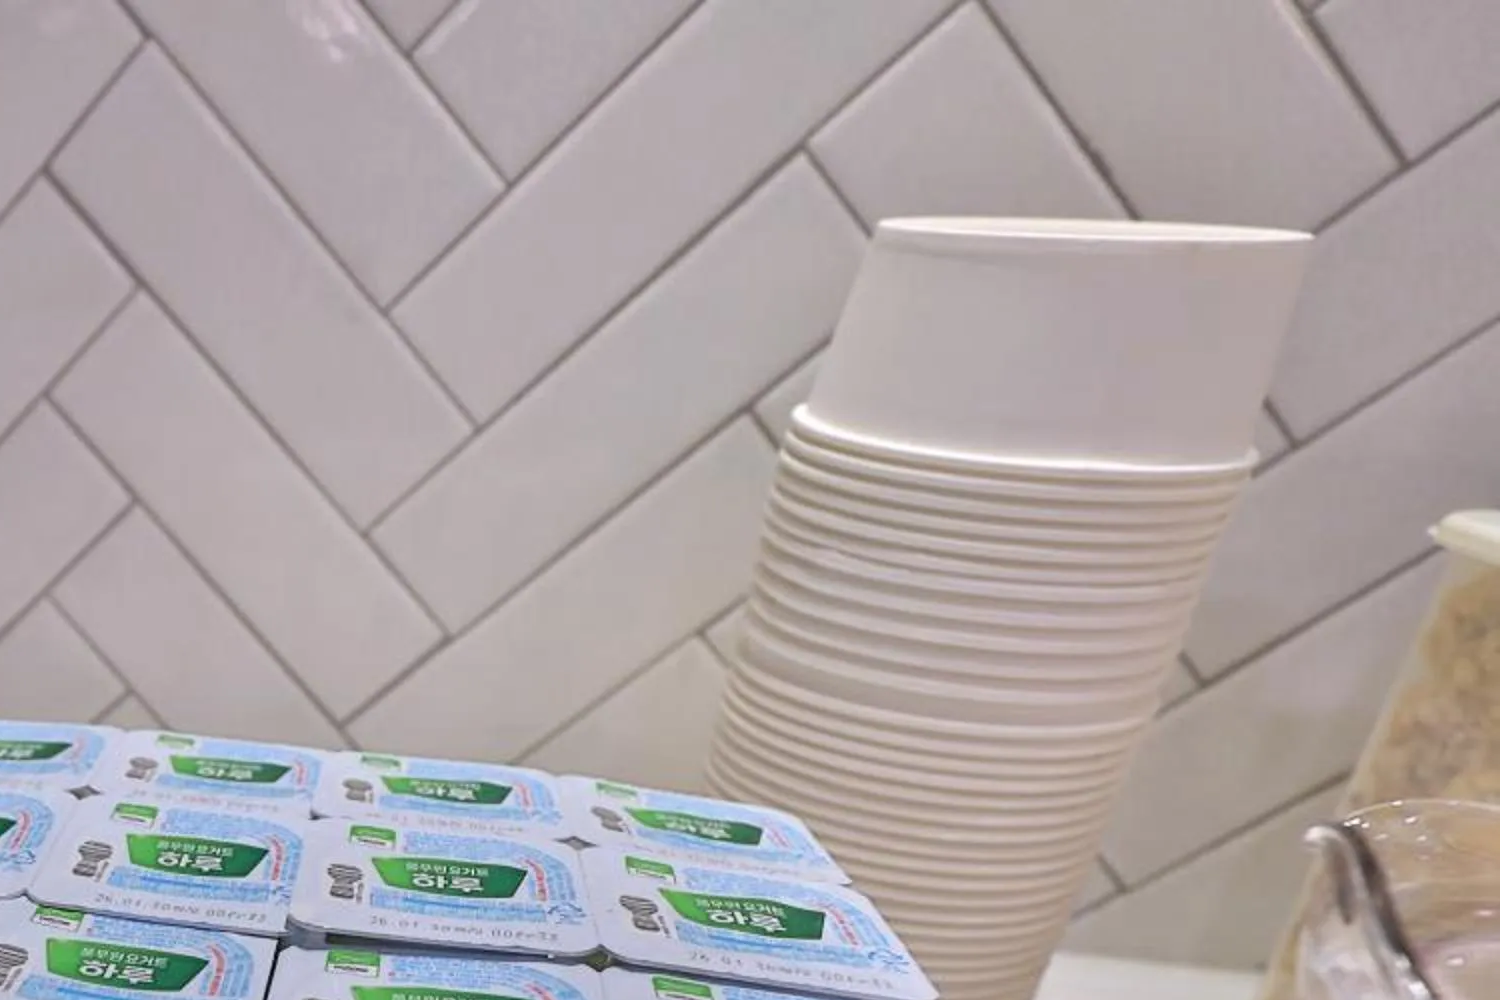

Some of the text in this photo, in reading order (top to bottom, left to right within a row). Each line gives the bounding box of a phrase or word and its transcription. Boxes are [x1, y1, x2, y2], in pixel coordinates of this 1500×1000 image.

[157, 850, 223, 873] 하루
[411, 872, 485, 893] 하루
[707, 909, 788, 934] 하루
[78, 958, 155, 985] 하루
